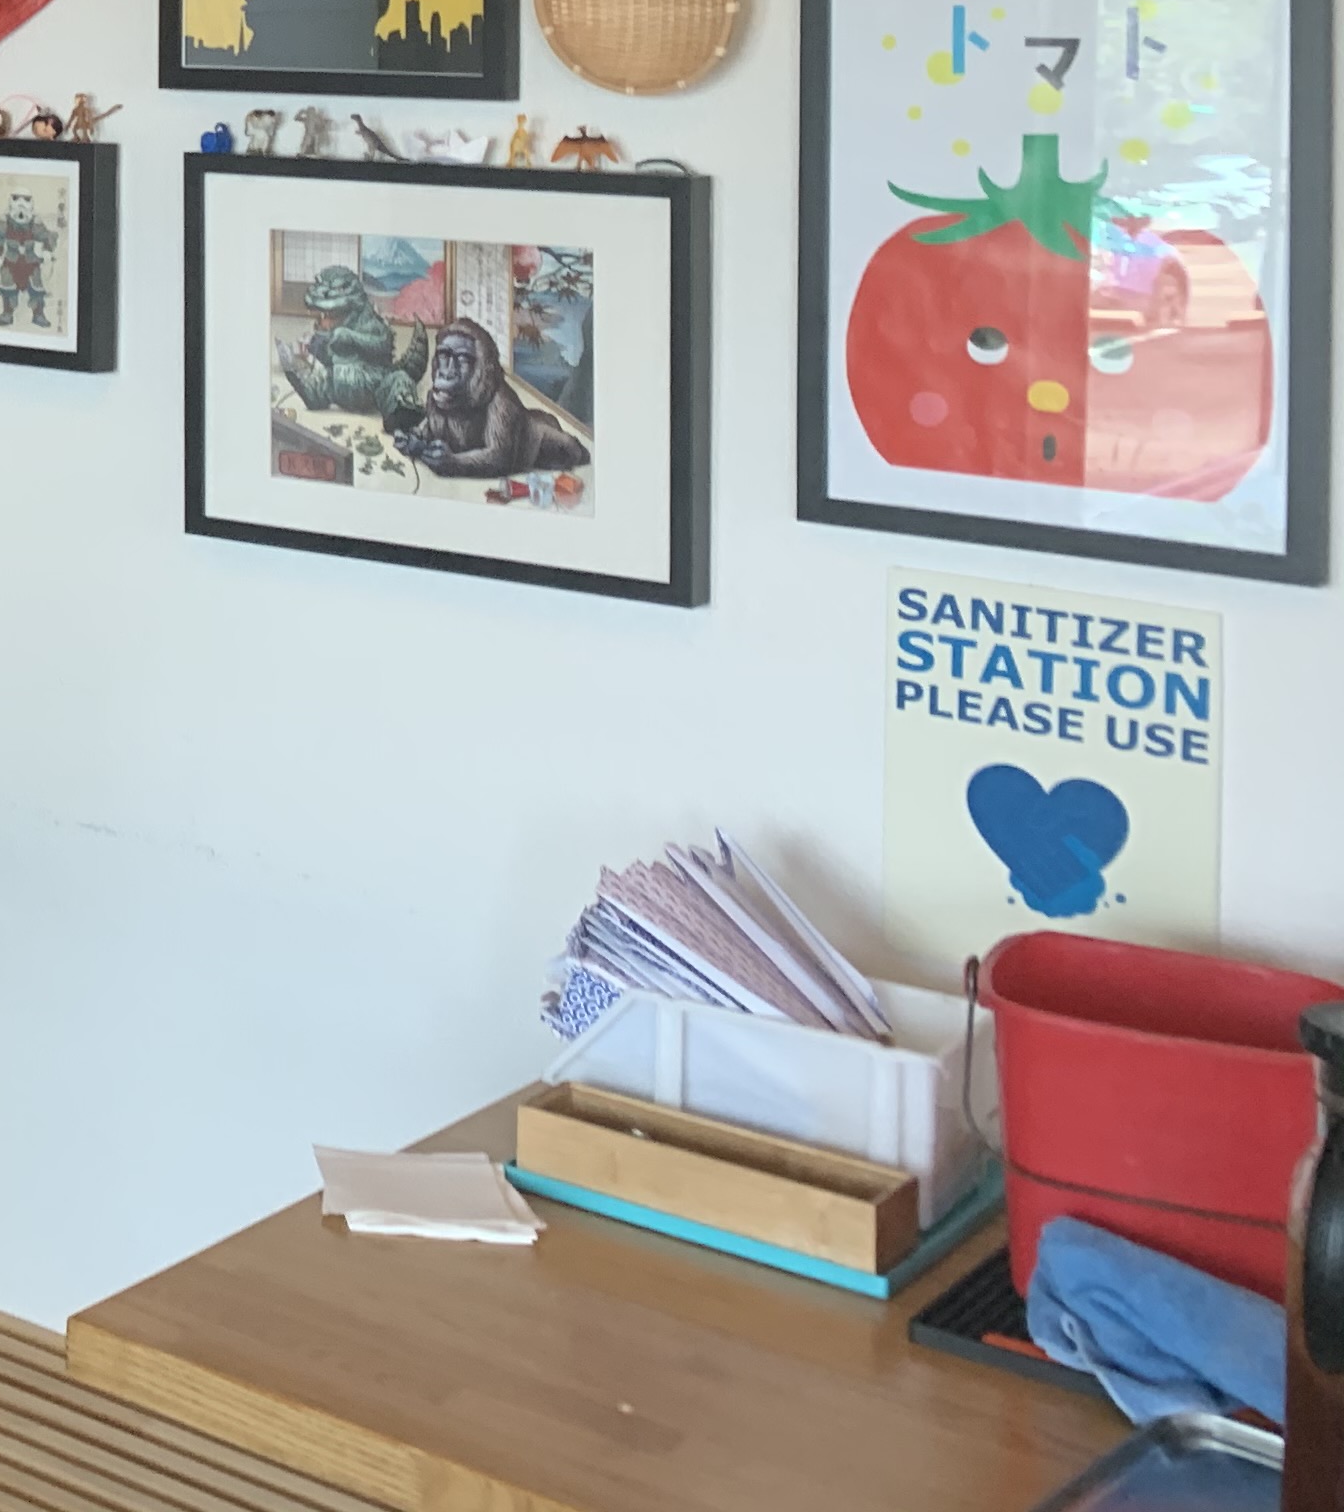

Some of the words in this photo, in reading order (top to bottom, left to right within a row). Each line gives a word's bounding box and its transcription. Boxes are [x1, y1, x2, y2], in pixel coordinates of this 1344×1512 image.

[952, 4, 1168, 91] トマト
[896, 587, 1209, 669] SANITIZER
[895, 631, 1211, 722] STATION
[895, 679, 1084, 744] PLEASE
[1105, 715, 1210, 765] USE
